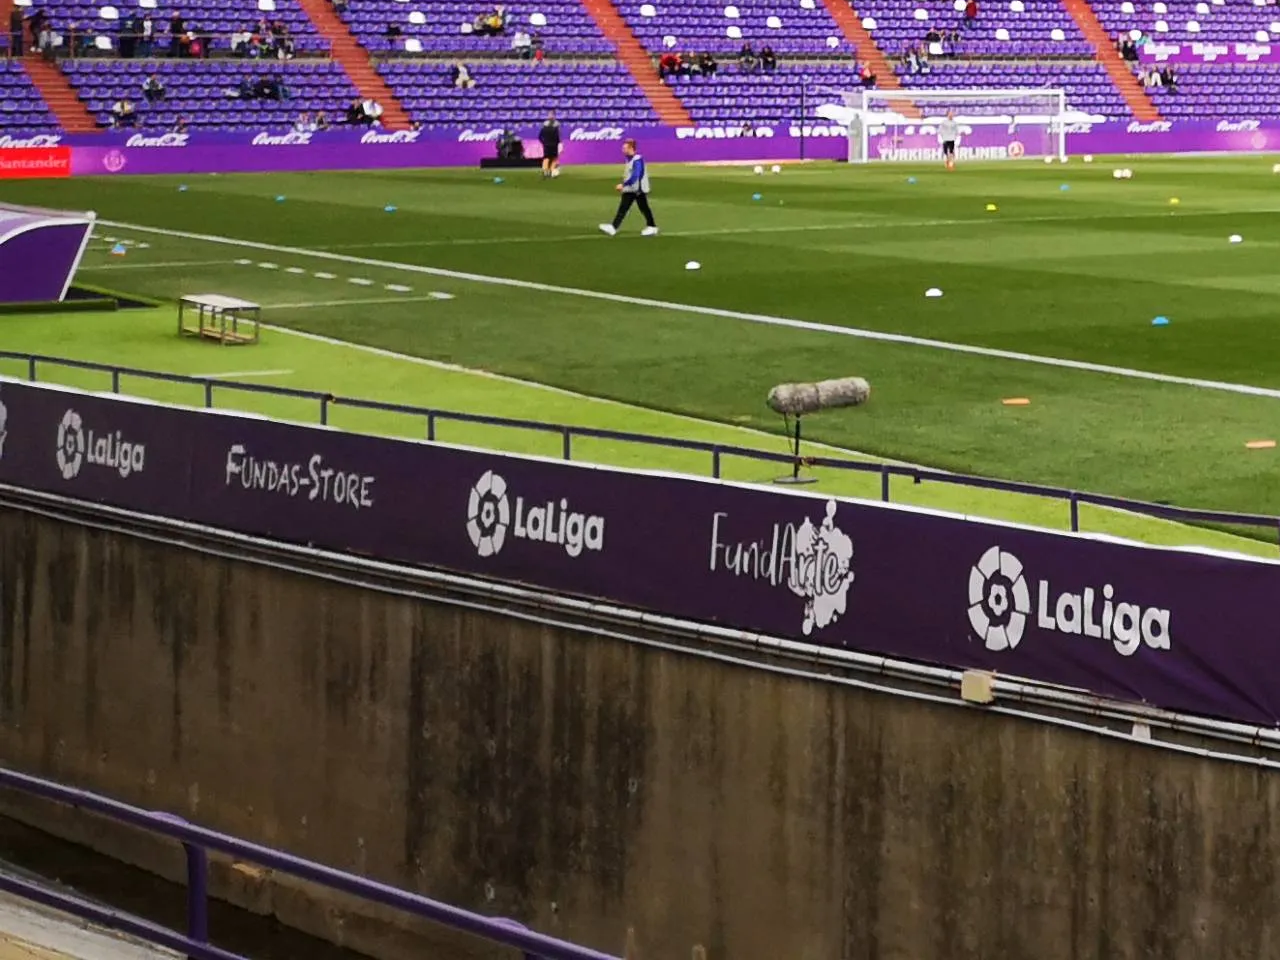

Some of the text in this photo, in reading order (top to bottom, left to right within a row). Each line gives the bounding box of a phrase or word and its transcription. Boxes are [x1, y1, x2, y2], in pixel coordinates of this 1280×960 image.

[950, 146, 1008, 161] IRLINES
[87, 429, 145, 478] LaLiga
[514, 496, 605, 557] LaLiga
[710, 512, 843, 595] FundArte
[1038, 582, 1171, 657] LaLiga
